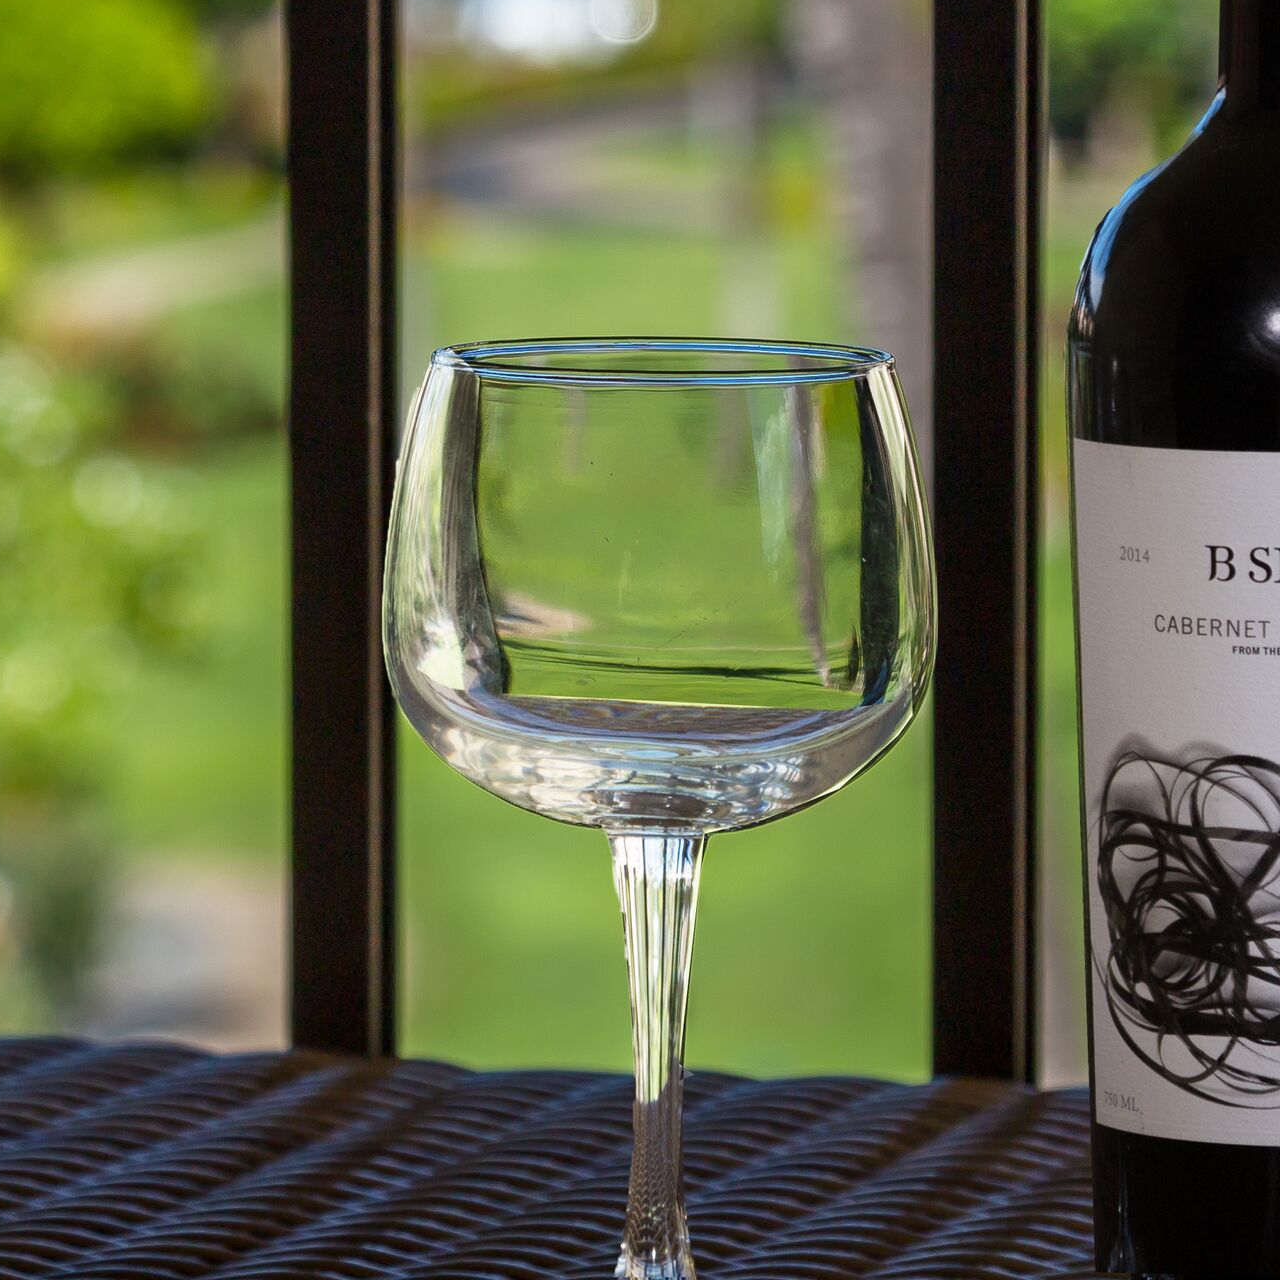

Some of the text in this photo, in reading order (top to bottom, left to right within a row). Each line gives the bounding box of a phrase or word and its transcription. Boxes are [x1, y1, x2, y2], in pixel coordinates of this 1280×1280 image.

[1119, 545, 1150, 564] 2014
[1204, 545, 1237, 582] B
[1153, 613, 1271, 639] CABERNET
[1232, 645, 1261, 656] FROM
[1104, 1090, 1119, 1108] 750
